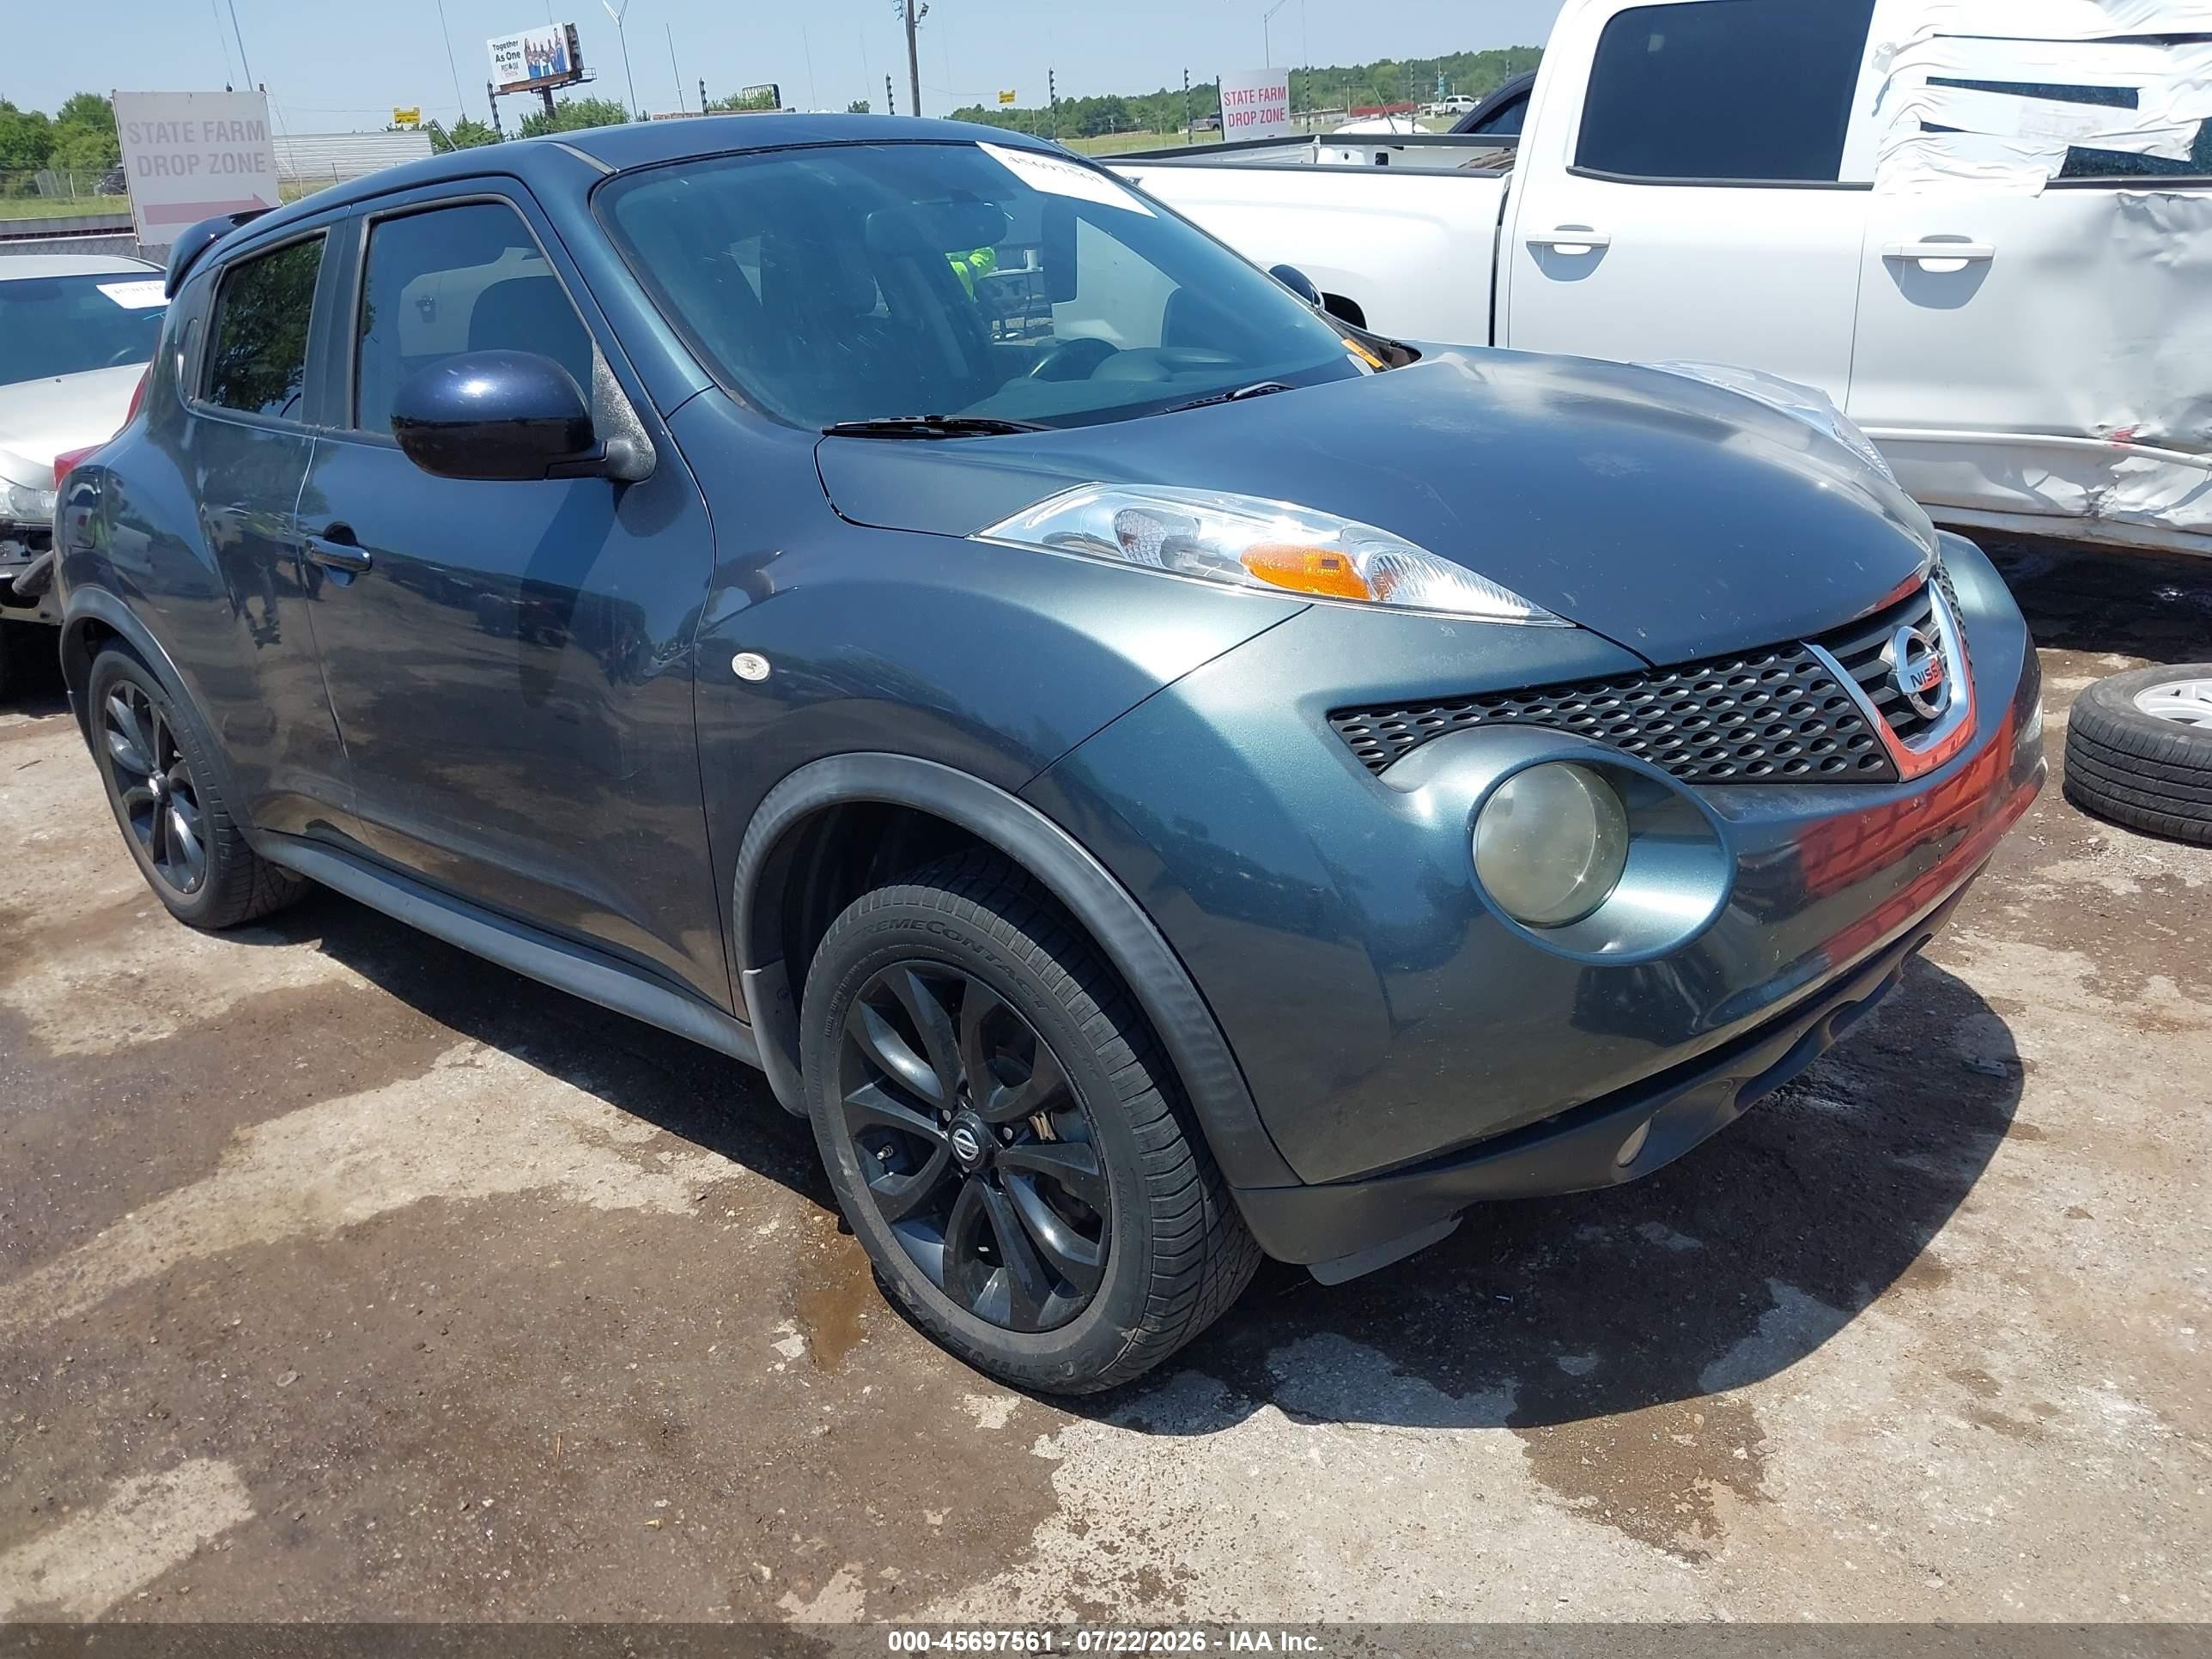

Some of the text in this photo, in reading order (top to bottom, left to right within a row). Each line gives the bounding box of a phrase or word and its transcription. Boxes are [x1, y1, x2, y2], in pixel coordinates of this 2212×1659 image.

[492, 40, 519, 52] Together
[495, 52, 521, 64] As One
[1224, 86, 1286, 106] STATE FARM
[1228, 107, 1285, 128] DROP ZONE
[127, 119, 266, 144] STATE FARM
[137, 152, 266, 177] DROP ZONE
[1909, 664, 1940, 688] NISS
